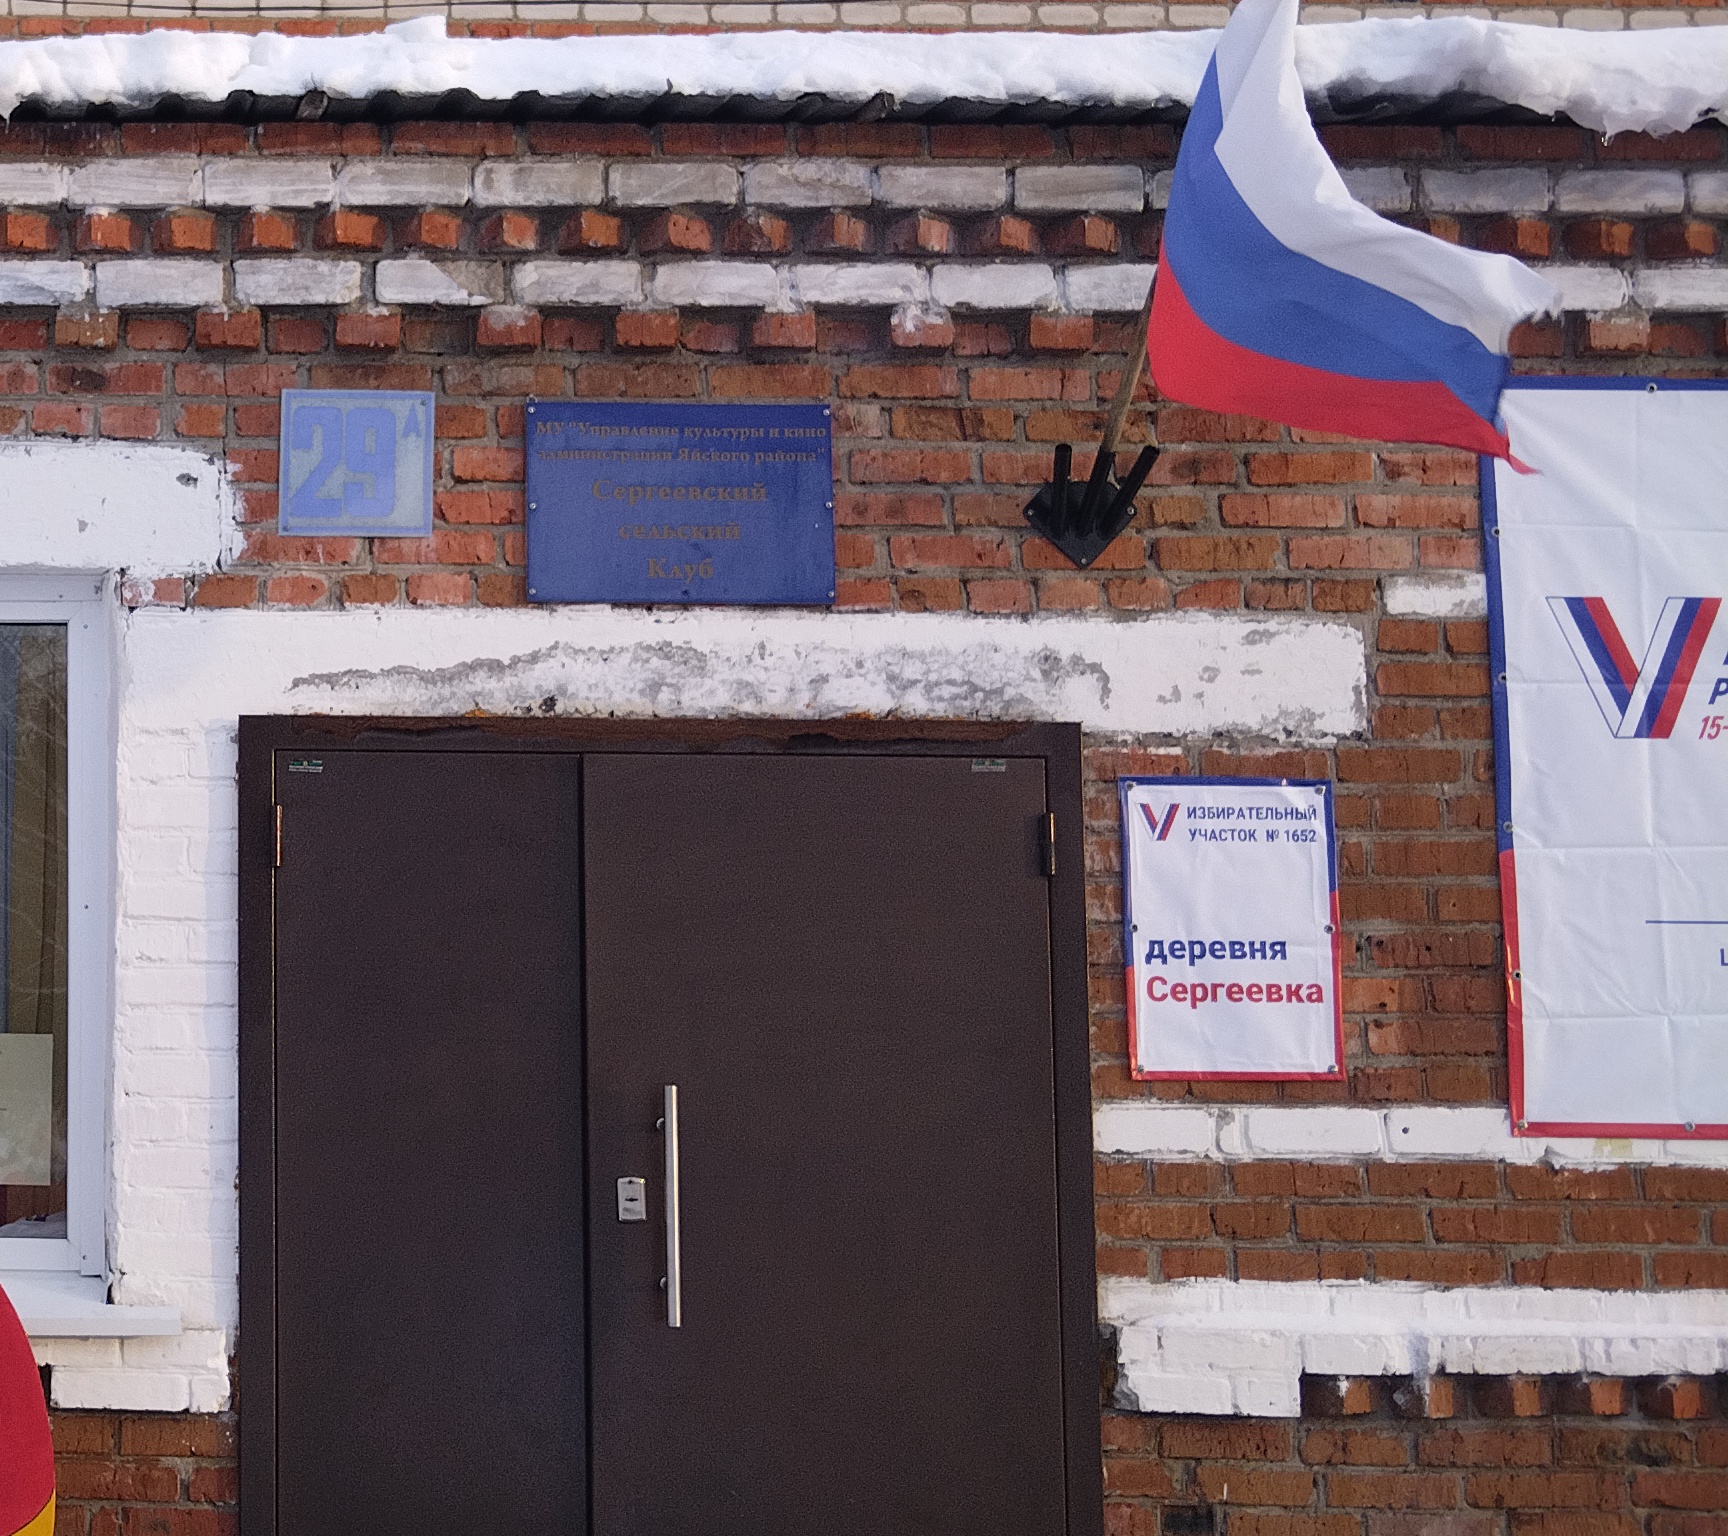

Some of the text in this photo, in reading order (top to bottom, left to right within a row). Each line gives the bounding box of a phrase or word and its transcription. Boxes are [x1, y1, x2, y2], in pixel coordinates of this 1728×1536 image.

[536, 421, 565, 436] МУ
[685, 427, 764, 442] культуры
[769, 427, 780, 438] и
[784, 427, 826, 439] кино
[289, 406, 396, 518] 29
[678, 447, 751, 462] Яйского
[592, 479, 768, 507] Сергеевский
[618, 521, 741, 541] сельский
[647, 557, 715, 584] Клуб
[1186, 804, 1317, 821] ИЗБИРАТЕЛЬНЫЙ
[1188, 828, 1317, 843] УЧАСТОК № 1652
[1145, 939, 1287, 966] деревня
[1146, 976, 1324, 1010] Сергеевка
